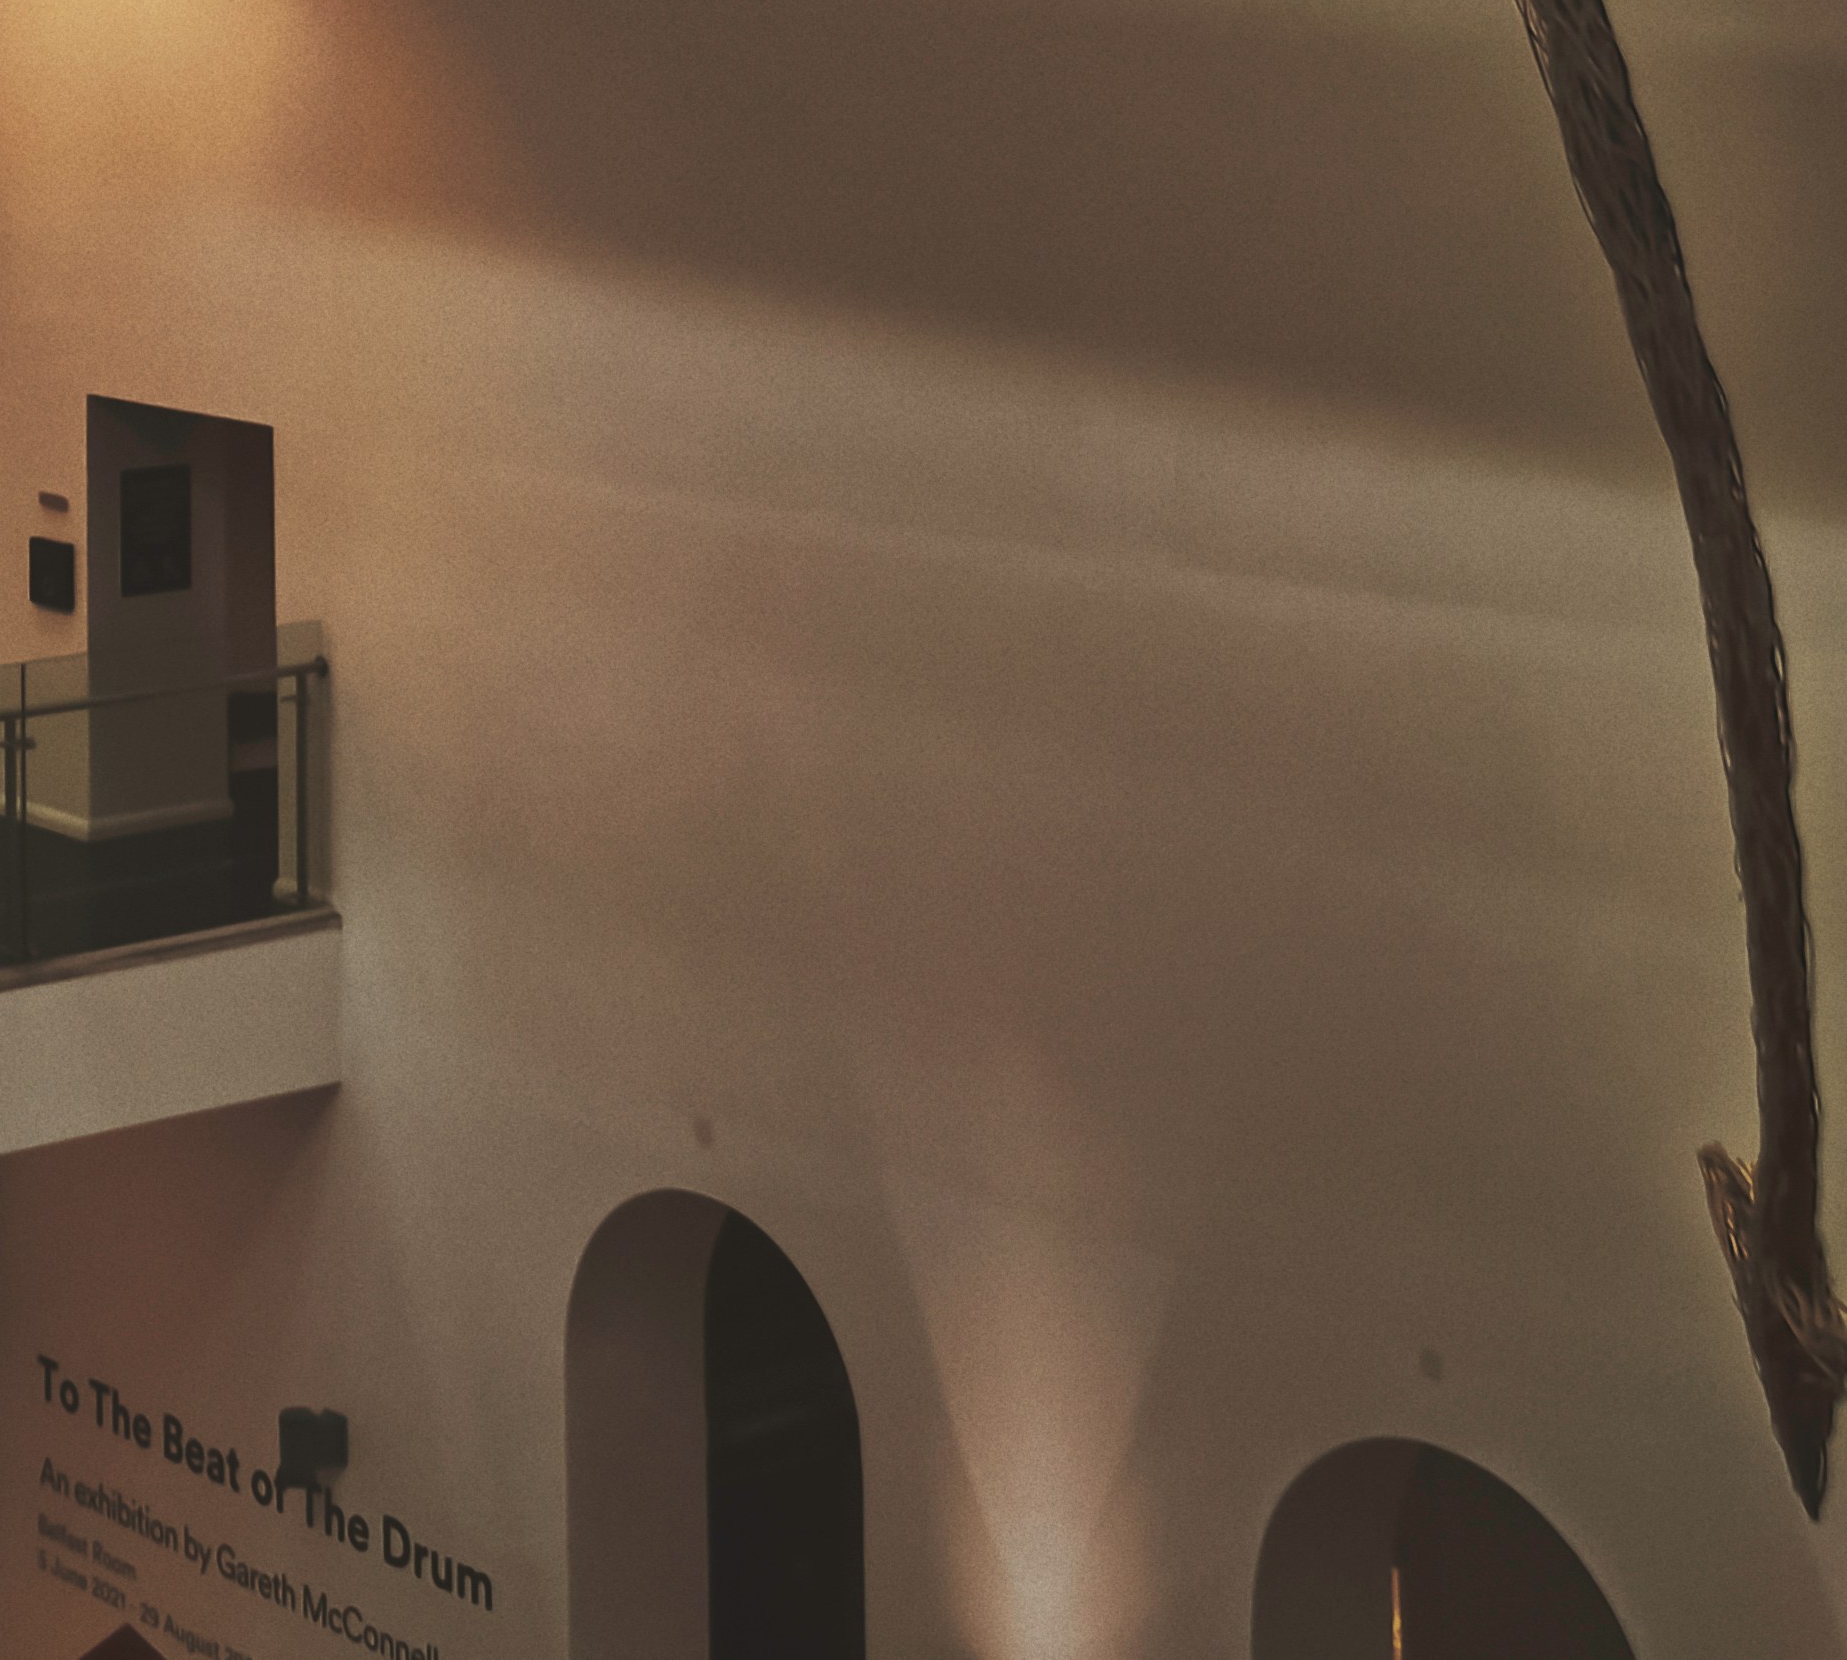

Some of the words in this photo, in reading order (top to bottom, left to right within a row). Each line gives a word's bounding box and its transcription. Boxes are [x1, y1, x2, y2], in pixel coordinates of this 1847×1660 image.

[37, 1352, 80, 1415] To
[88, 1377, 152, 1450] The
[163, 1411, 241, 1494] Beat
[300, 1475, 370, 1553] The
[382, 1513, 493, 1612] Drum
[39, 1456, 71, 1498] An
[74, 1481, 179, 1553] exhibition
[184, 1524, 211, 1575] by
[216, 1542, 296, 1612] Gareth
